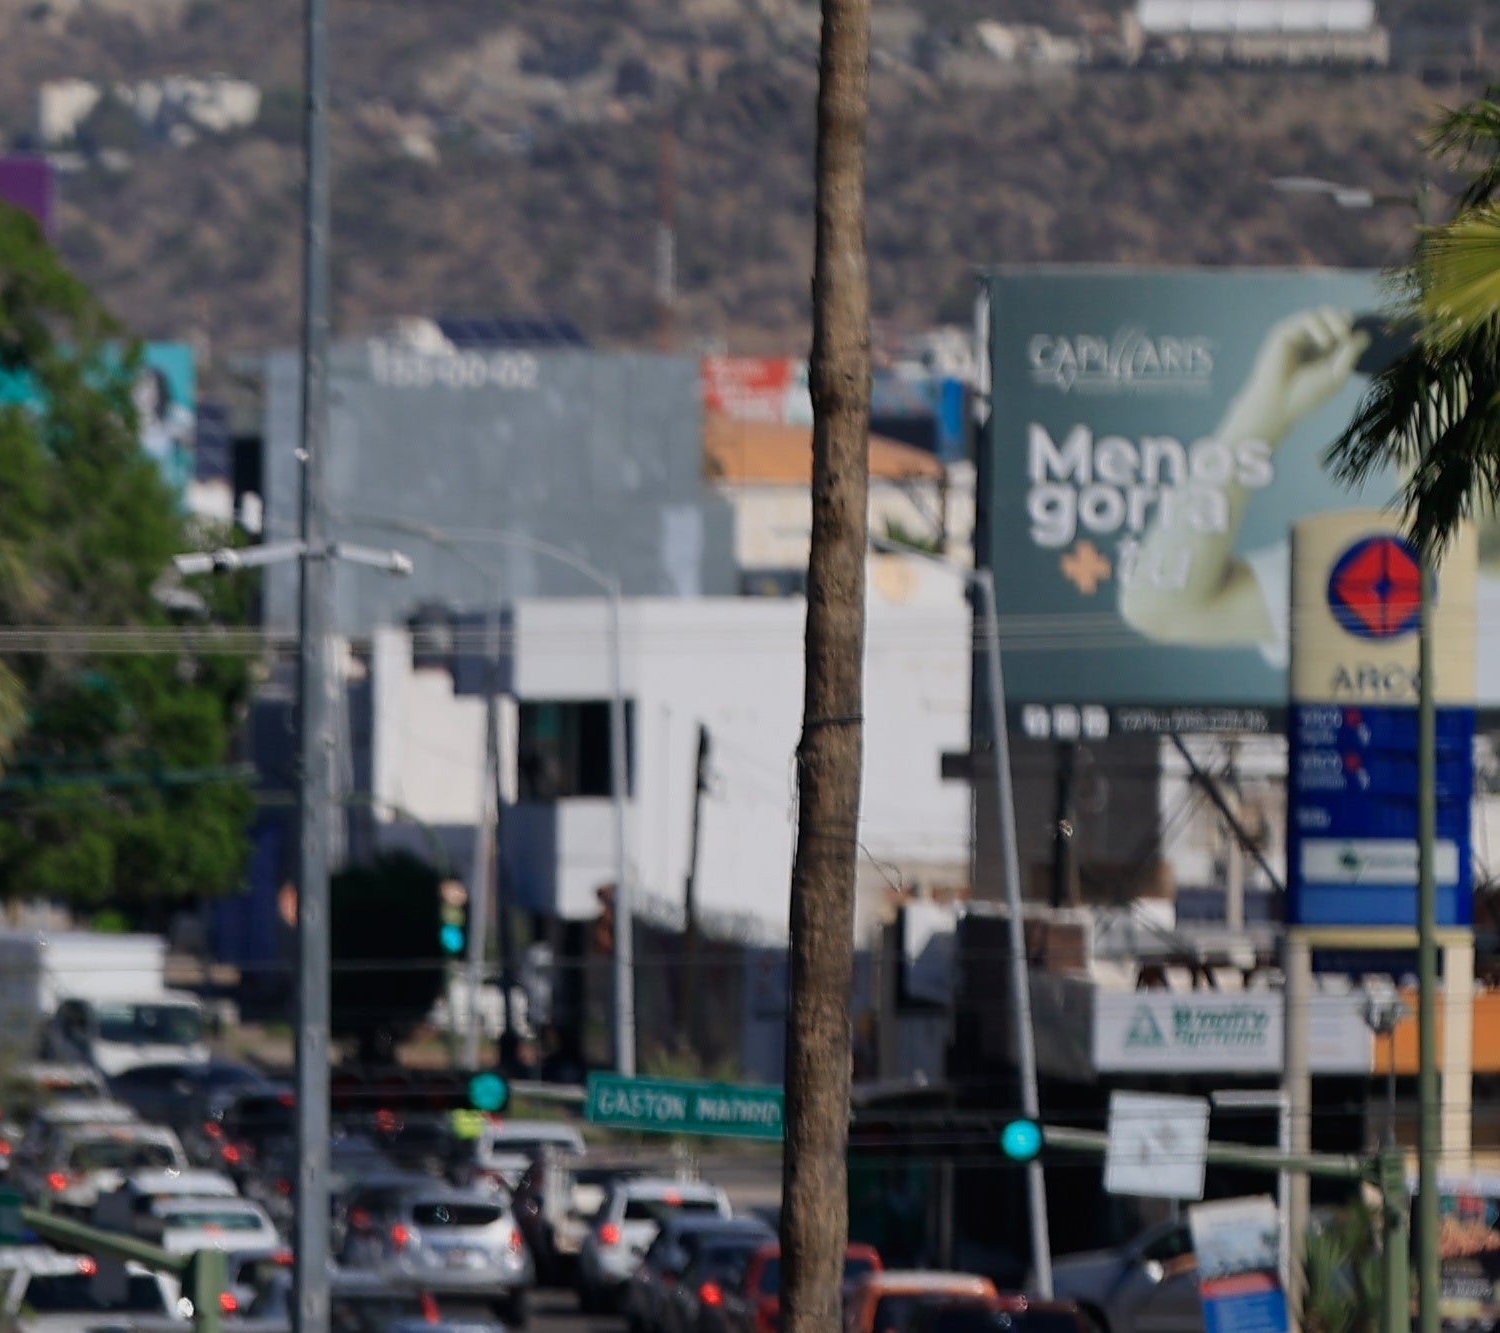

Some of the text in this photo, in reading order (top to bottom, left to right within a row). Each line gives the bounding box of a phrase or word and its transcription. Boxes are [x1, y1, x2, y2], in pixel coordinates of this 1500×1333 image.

[1028, 423, 1274, 488] Menos
[1028, 482, 1230, 548] gorra
[1117, 538, 1192, 592] tu
[600, 1087, 685, 1121] GASTON
